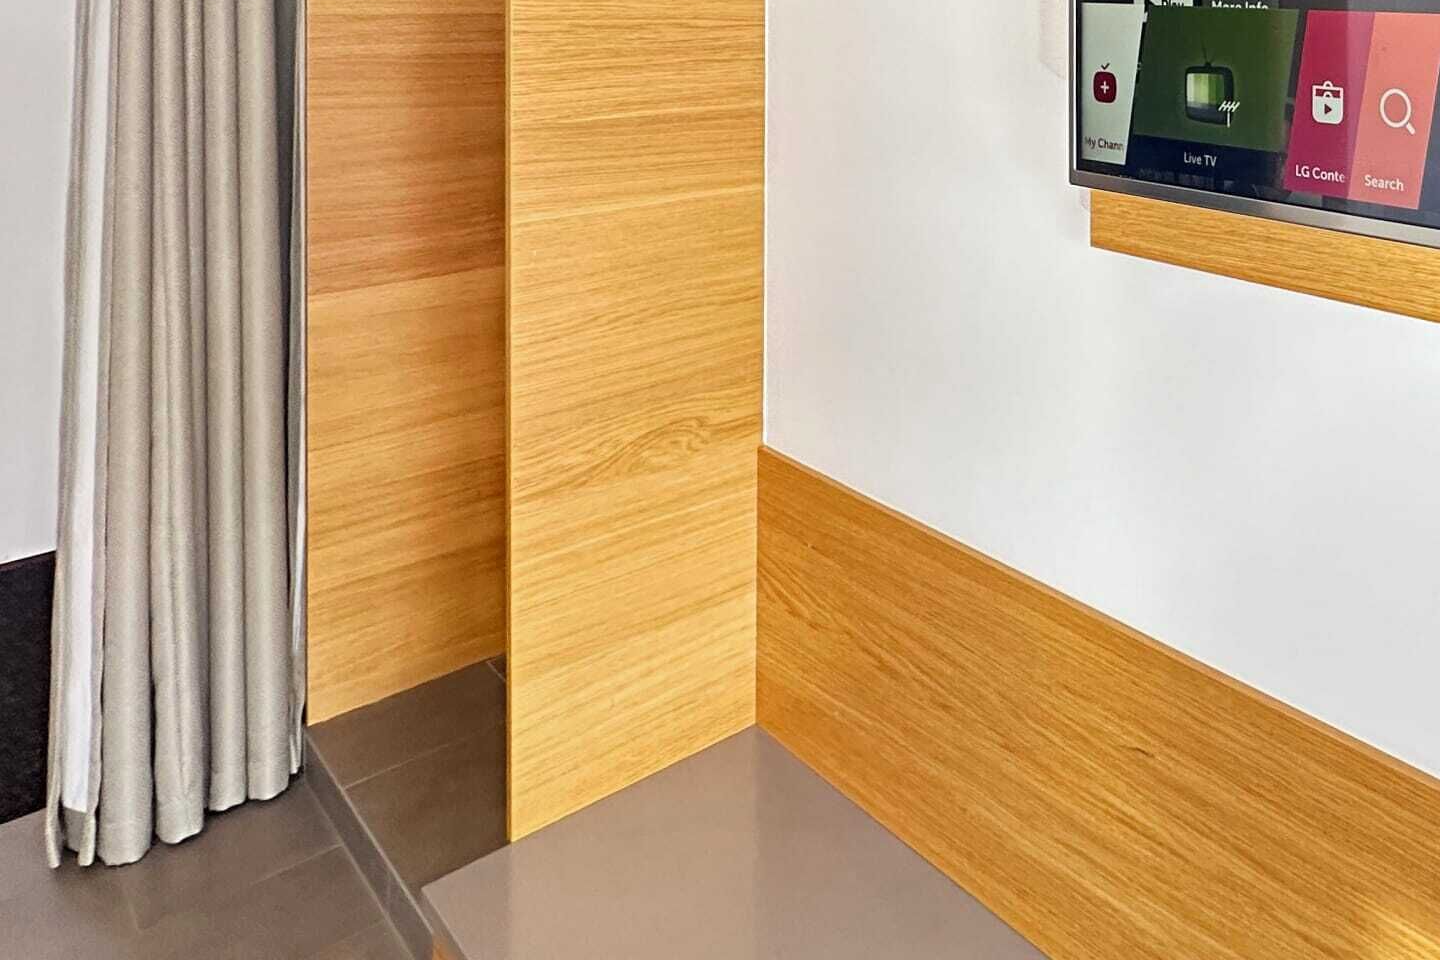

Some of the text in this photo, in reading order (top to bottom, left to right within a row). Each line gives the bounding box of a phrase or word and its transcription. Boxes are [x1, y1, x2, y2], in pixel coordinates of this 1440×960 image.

[1183, 151, 1217, 168] Live TV
[1295, 164, 1345, 183] LG Conte
[1364, 174, 1404, 191] Search
